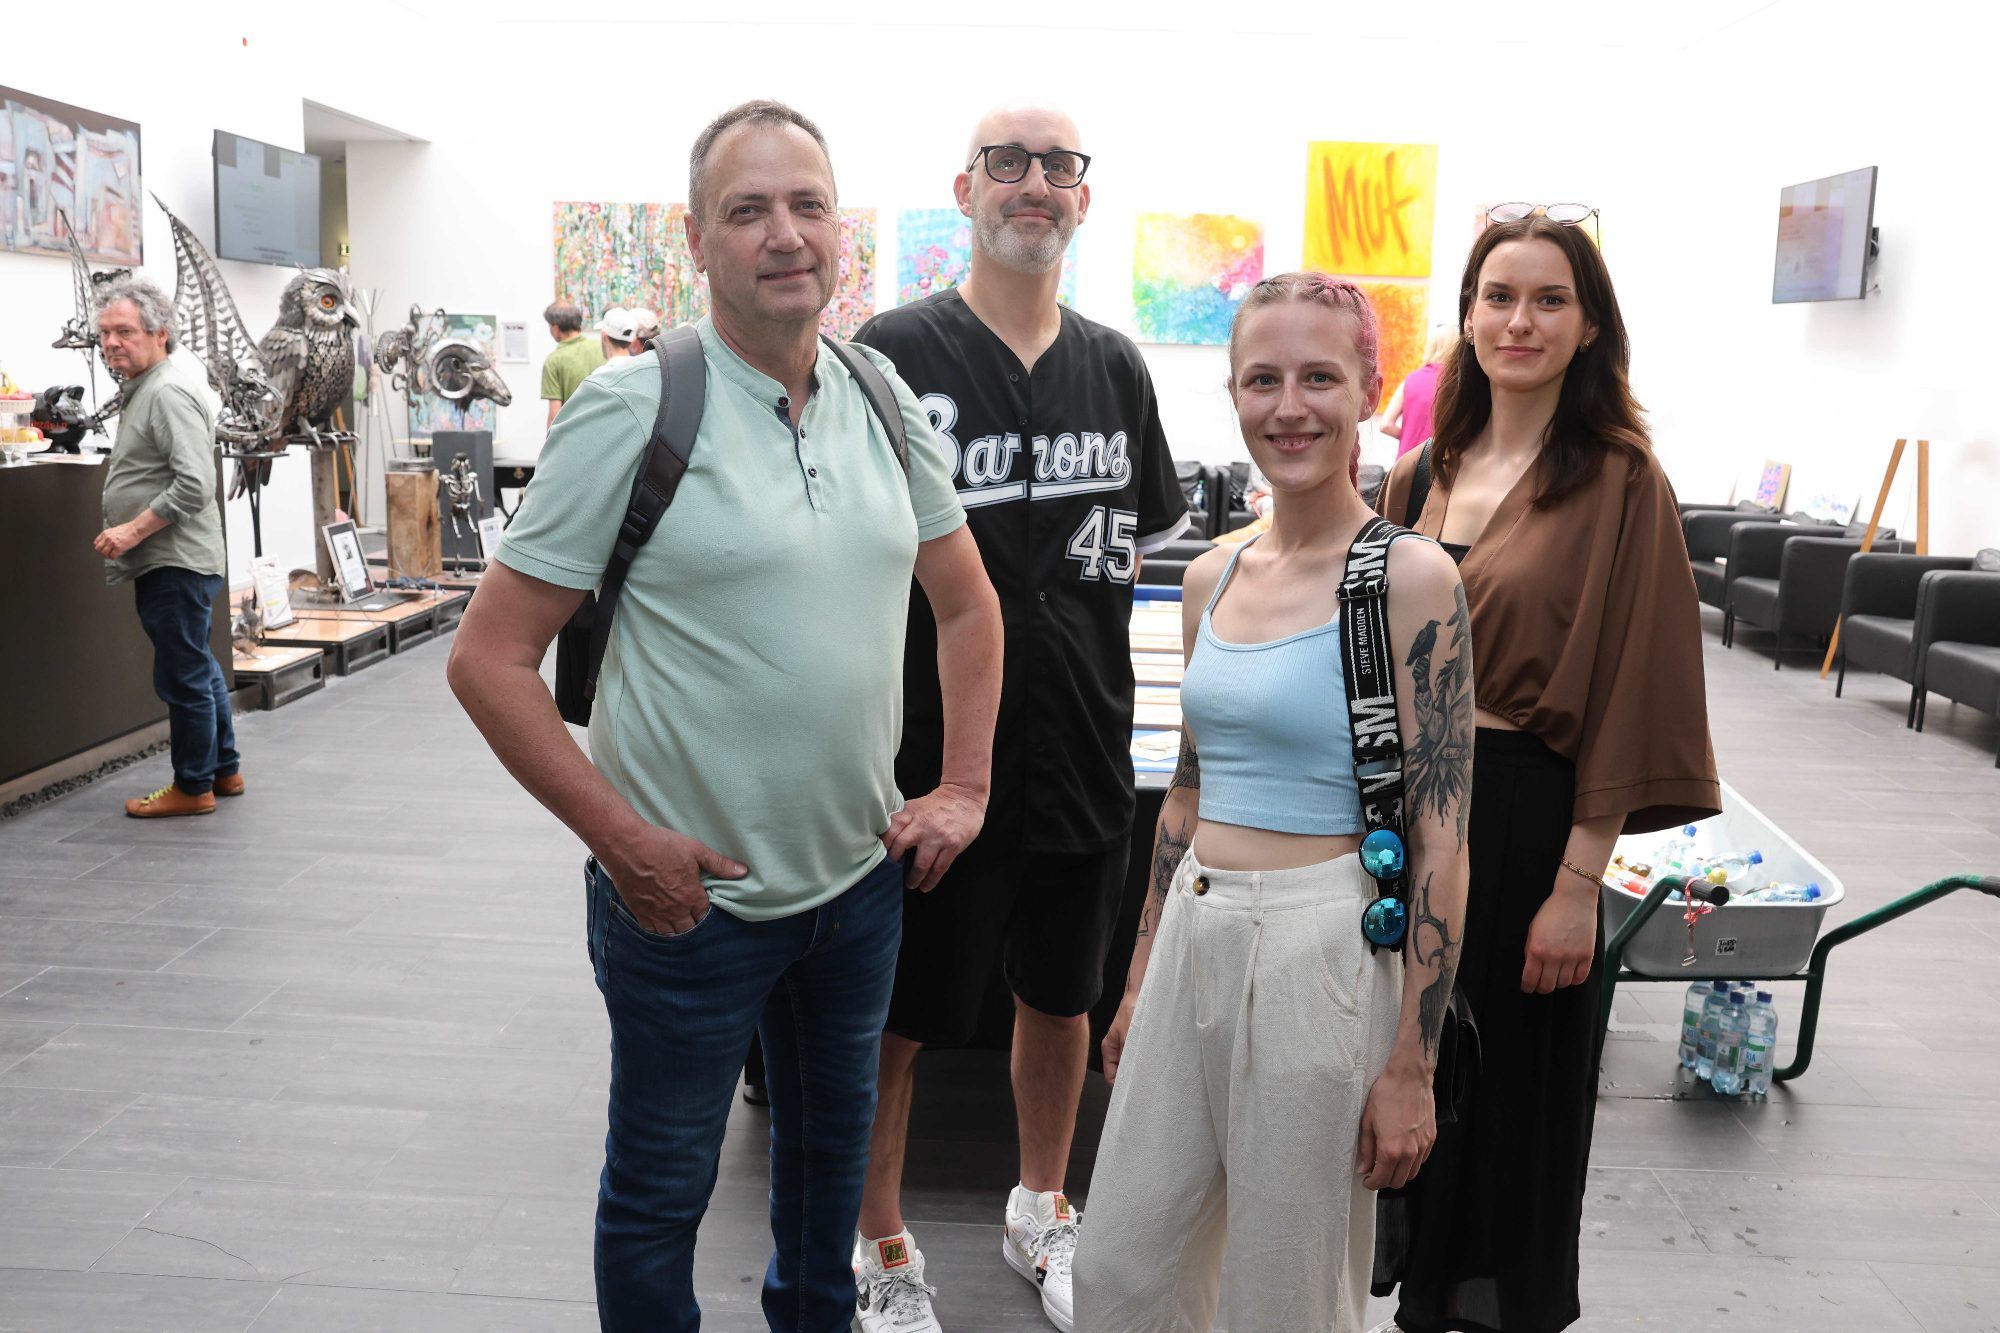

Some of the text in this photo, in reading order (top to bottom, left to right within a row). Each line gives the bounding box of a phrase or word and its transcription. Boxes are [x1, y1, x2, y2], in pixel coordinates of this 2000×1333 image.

[1064, 505, 1138, 584] 45
[1356, 607, 1372, 676] STEVE MADDEN
